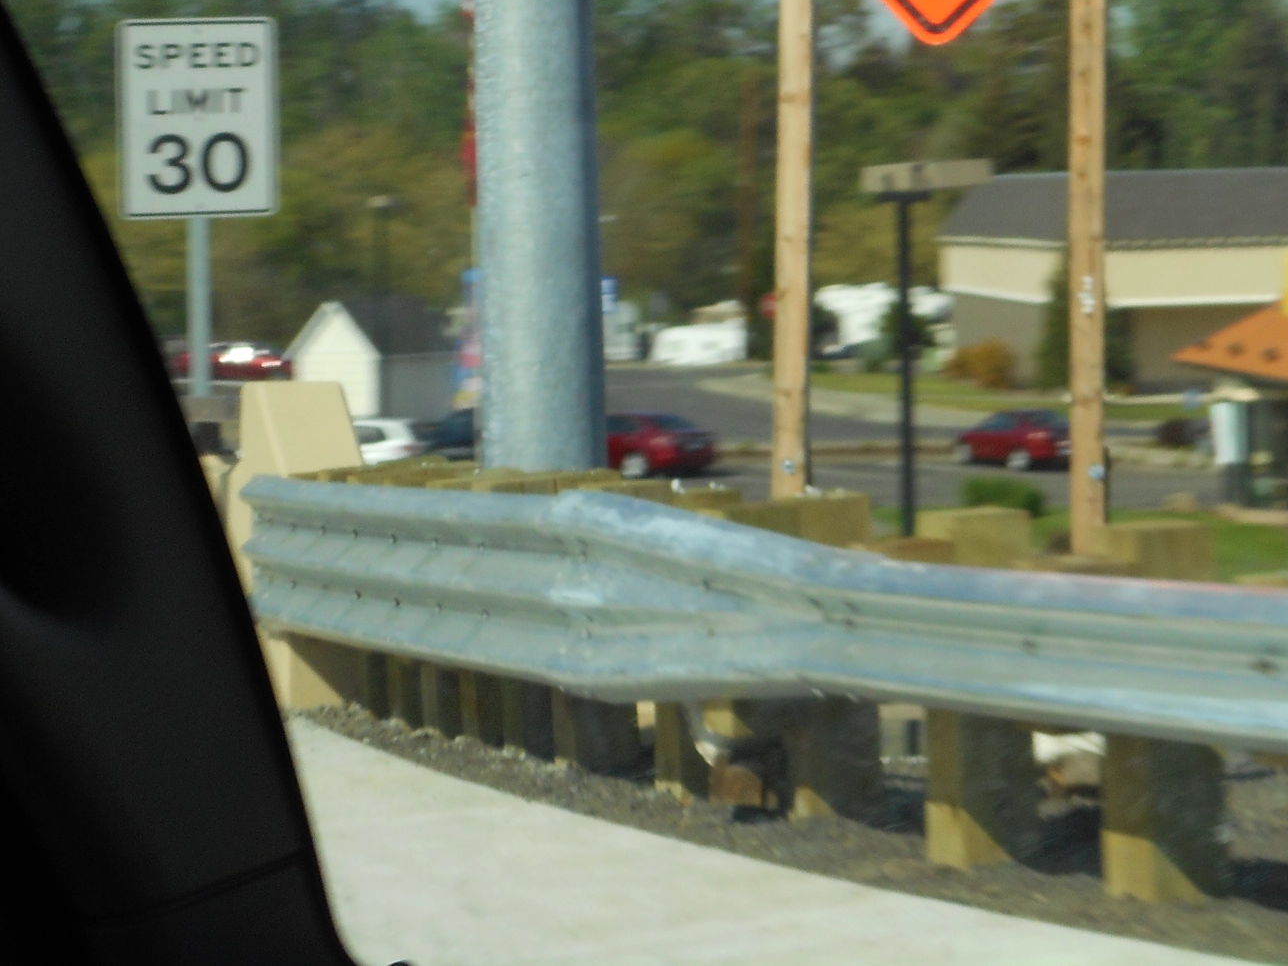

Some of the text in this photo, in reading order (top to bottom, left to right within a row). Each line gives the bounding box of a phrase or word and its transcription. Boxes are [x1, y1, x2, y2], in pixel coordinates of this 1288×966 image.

[136, 41, 260, 69] SPEED
[147, 88, 246, 115] LIMIT
[147, 132, 250, 194] 30
